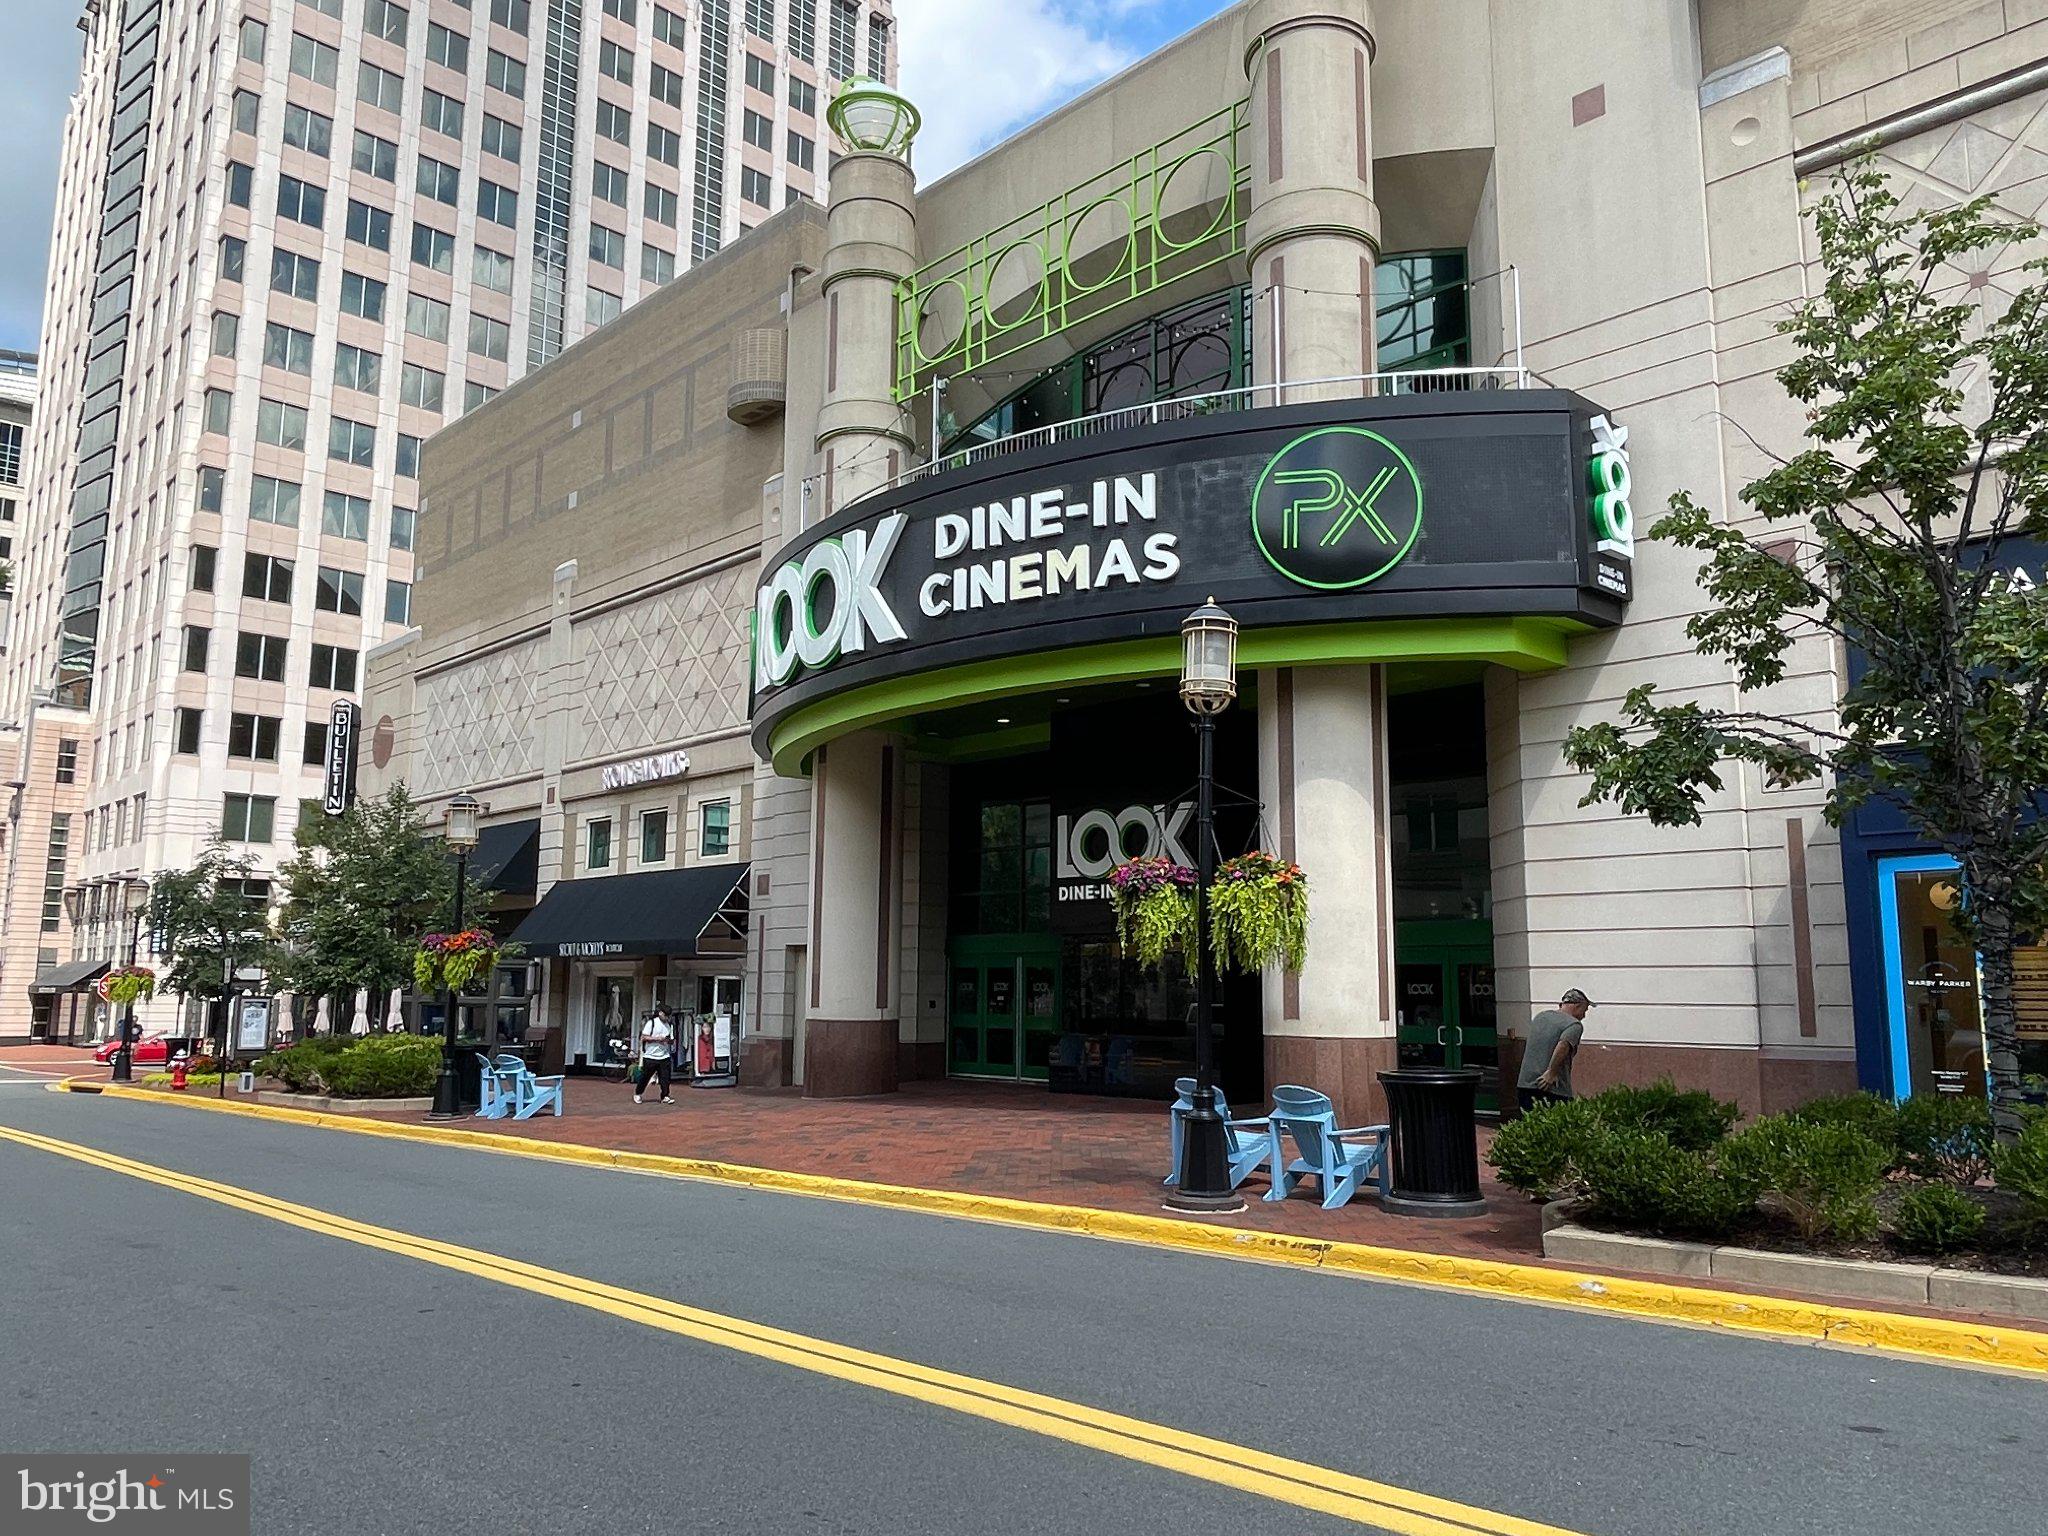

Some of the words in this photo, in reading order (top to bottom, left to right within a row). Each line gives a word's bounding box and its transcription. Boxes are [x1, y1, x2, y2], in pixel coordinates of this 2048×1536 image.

[935, 472, 1156, 559] DINE-IN
[1274, 466, 1399, 549] PX
[755, 513, 909, 695] LOOK
[919, 532, 1181, 617] CINEMAS
[328, 712, 348, 808] BULLETIN
[1057, 801, 1199, 880] LOOK
[1907, 979, 1936, 987] WARBY
[1939, 980, 1971, 988] PARKER
